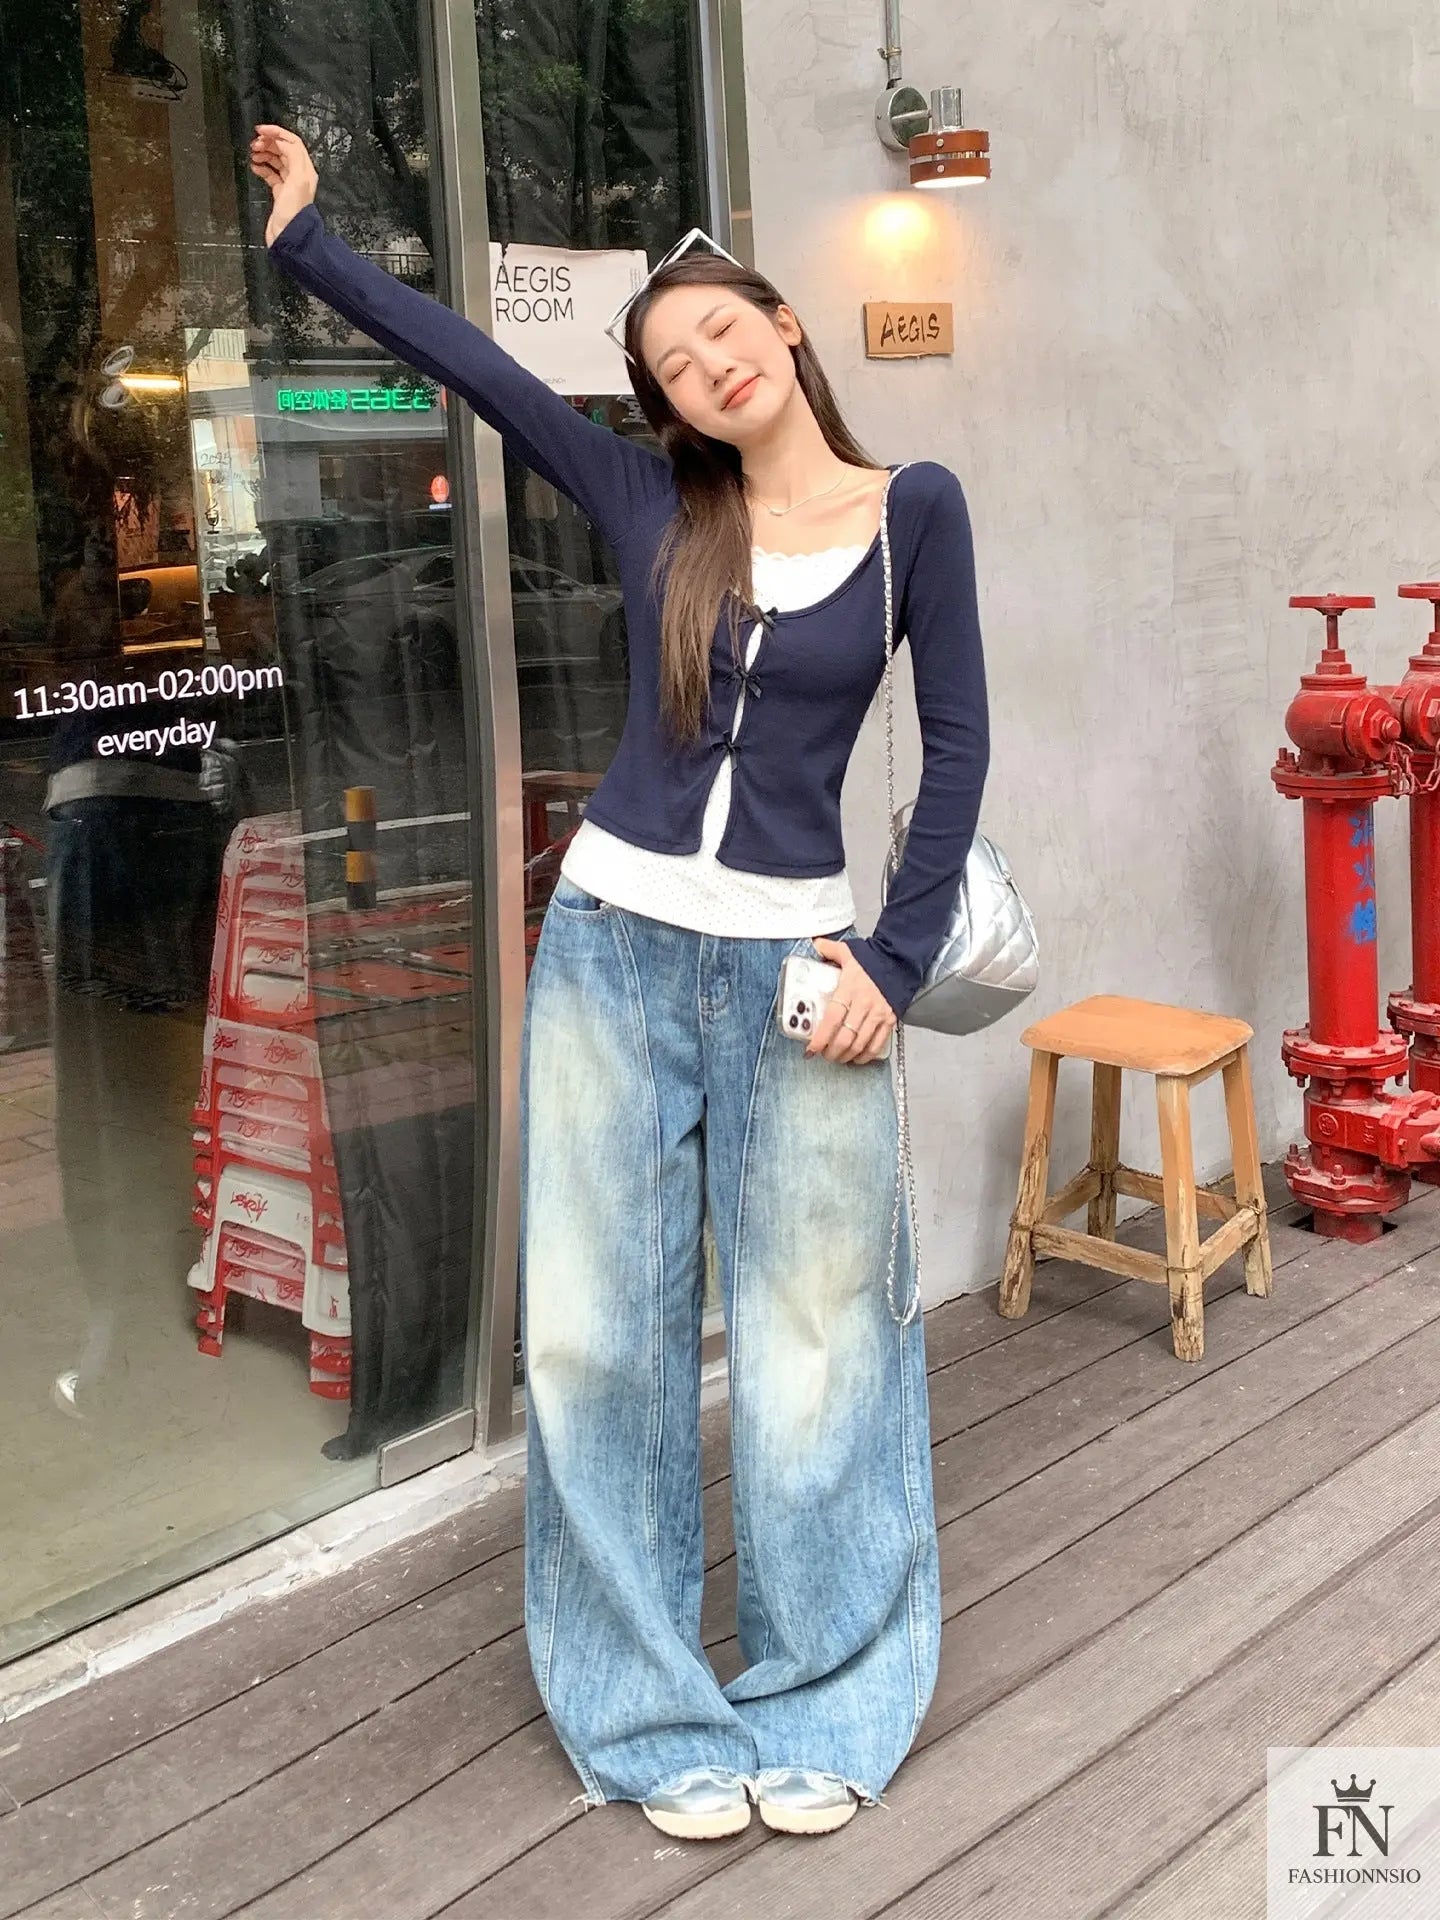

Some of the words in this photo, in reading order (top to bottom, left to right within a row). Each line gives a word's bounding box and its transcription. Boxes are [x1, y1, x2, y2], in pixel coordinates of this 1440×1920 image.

[495, 265, 571, 293] AEGIS
[495, 298, 574, 322] ROOM
[880, 311, 940, 347] AEGIS
[14, 664, 284, 720] 11:30am-02:00pm
[97, 717, 216, 756] everyday
